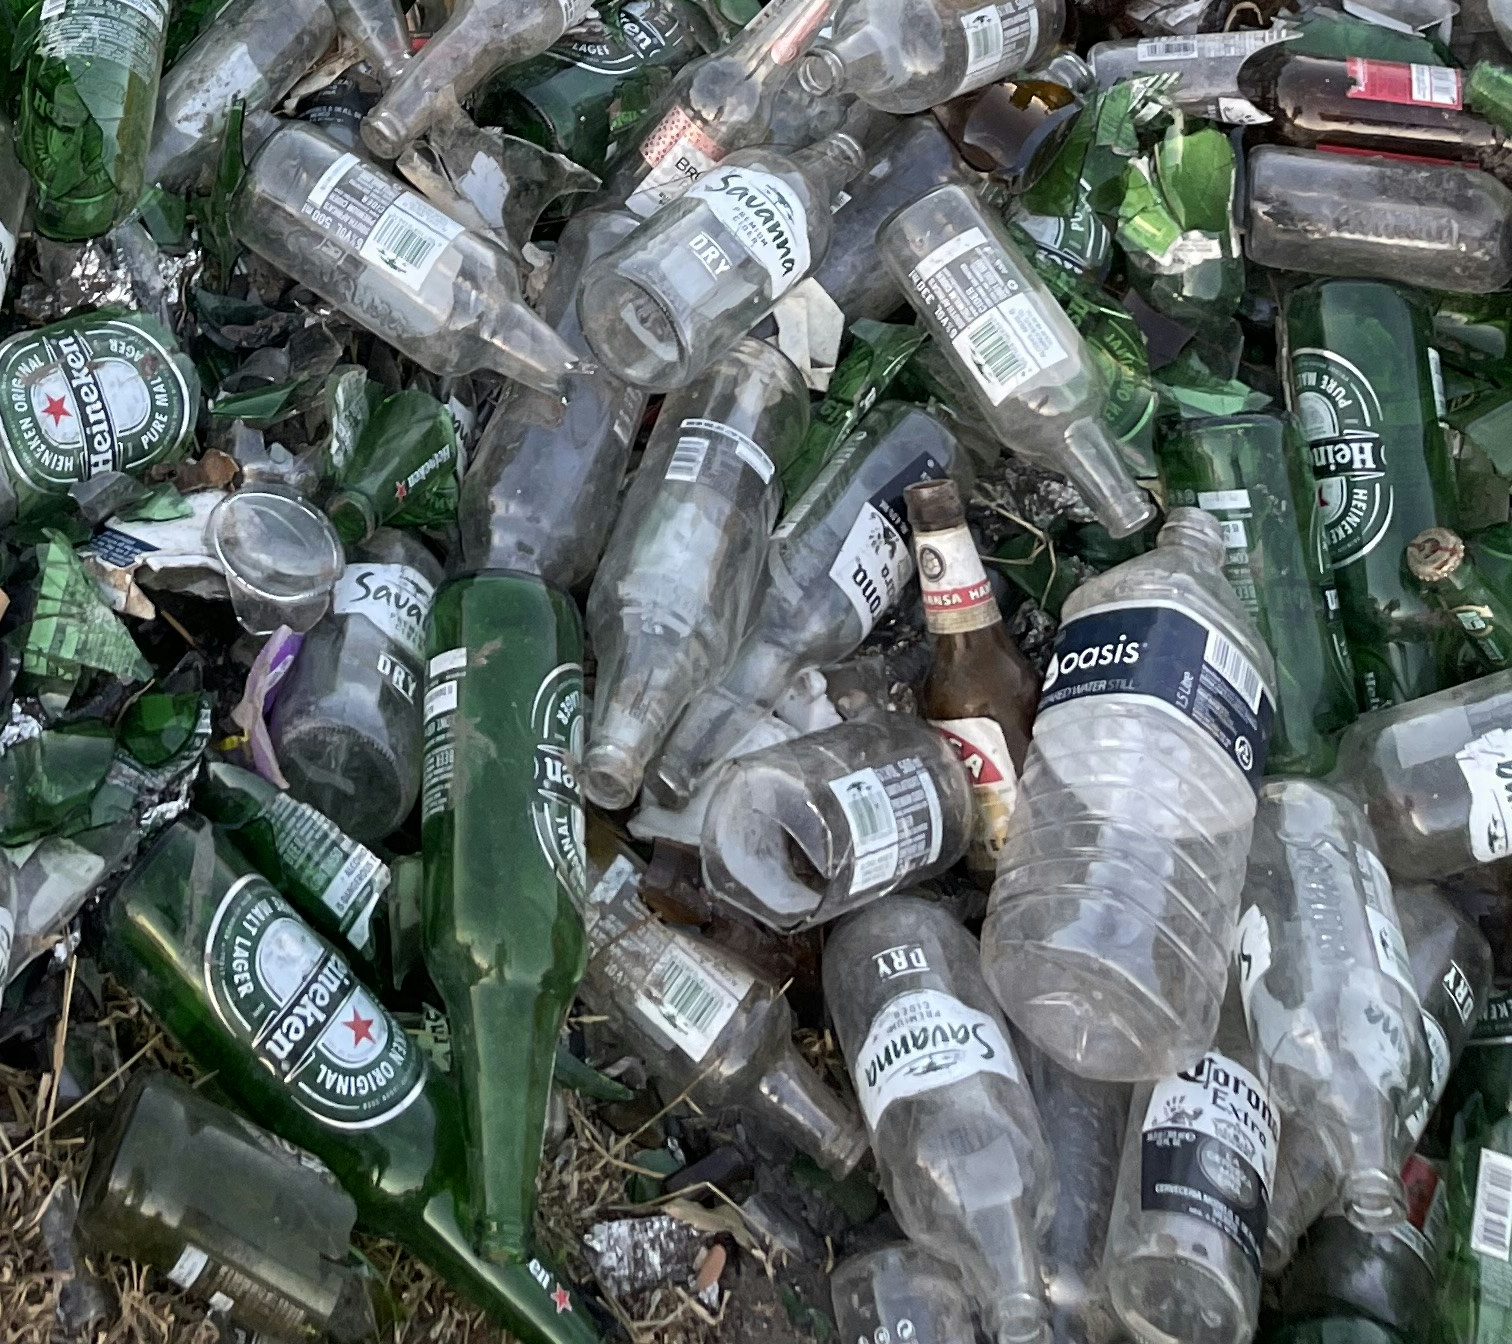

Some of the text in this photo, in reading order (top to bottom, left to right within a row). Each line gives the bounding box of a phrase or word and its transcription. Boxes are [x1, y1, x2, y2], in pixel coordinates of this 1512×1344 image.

[704, 174, 797, 278] Savanna
[730, 215, 757, 250] CIDER
[732, 205, 769, 249] PREMIUM
[688, 232, 731, 276] DRY
[12, 354, 45, 413] ORIGINAL
[57, 333, 117, 473] Heineken
[12, 412, 77, 473] HEINEKEN
[139, 411, 170, 448] PURE
[1310, 441, 1377, 467] Hein
[353, 570, 429, 619] Sava
[376, 653, 419, 698] DRY
[1059, 635, 1142, 674] oasis
[1072, 675, 1136, 699] WATER STILL
[229, 937, 255, 998] LAGER
[875, 952, 928, 979] DRY
[315, 1052, 394, 1095] ORIGINAL
[864, 1020, 998, 1092] Savanna
